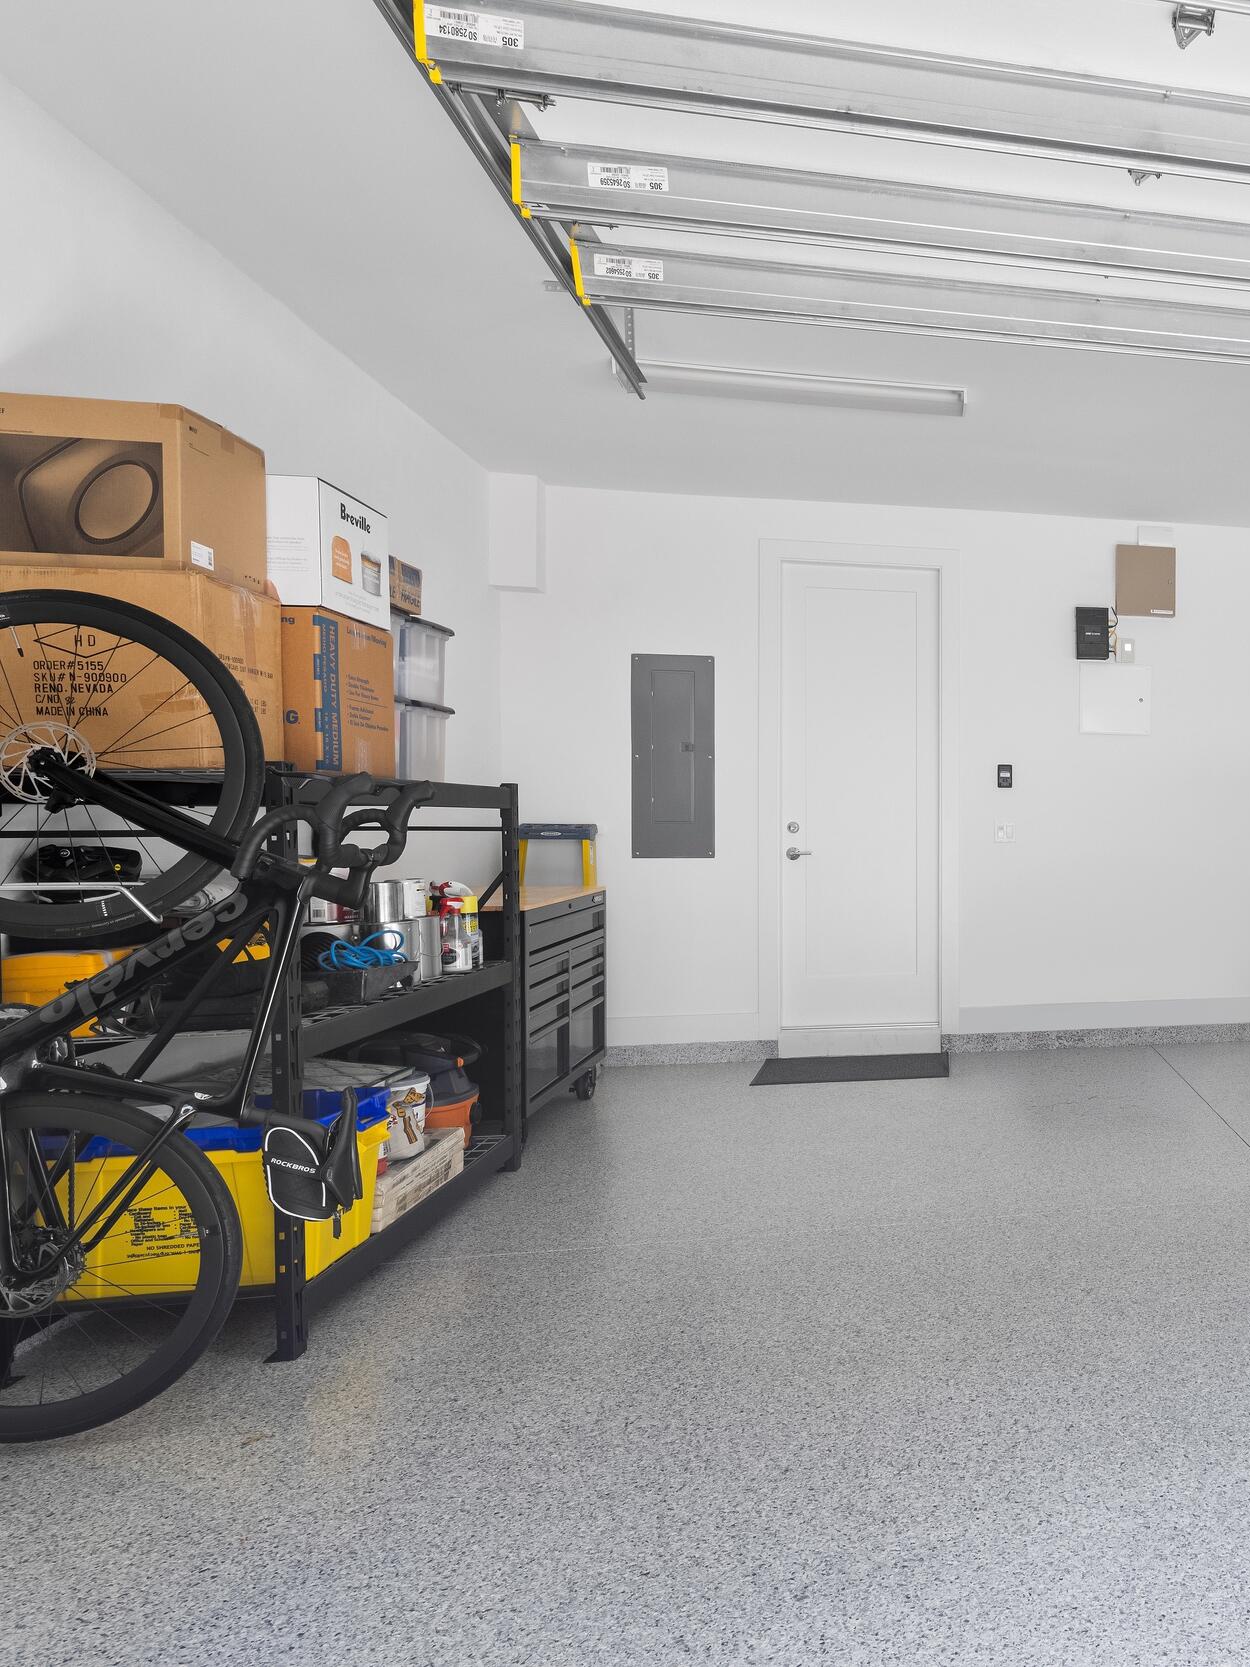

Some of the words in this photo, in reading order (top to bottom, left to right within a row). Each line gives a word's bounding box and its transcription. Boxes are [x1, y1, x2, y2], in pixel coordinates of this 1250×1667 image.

[501, 36, 519, 48] 305
[649, 182, 663, 190] 305
[340, 502, 371, 534] Breville
[77, 661, 104, 670] 5155
[71, 684, 114, 693] NEVADA
[36, 706, 63, 716] MADE
[66, 706, 76, 716] IN
[79, 707, 109, 716] CHINA
[270, 1157, 317, 1174] ROCKBROS
